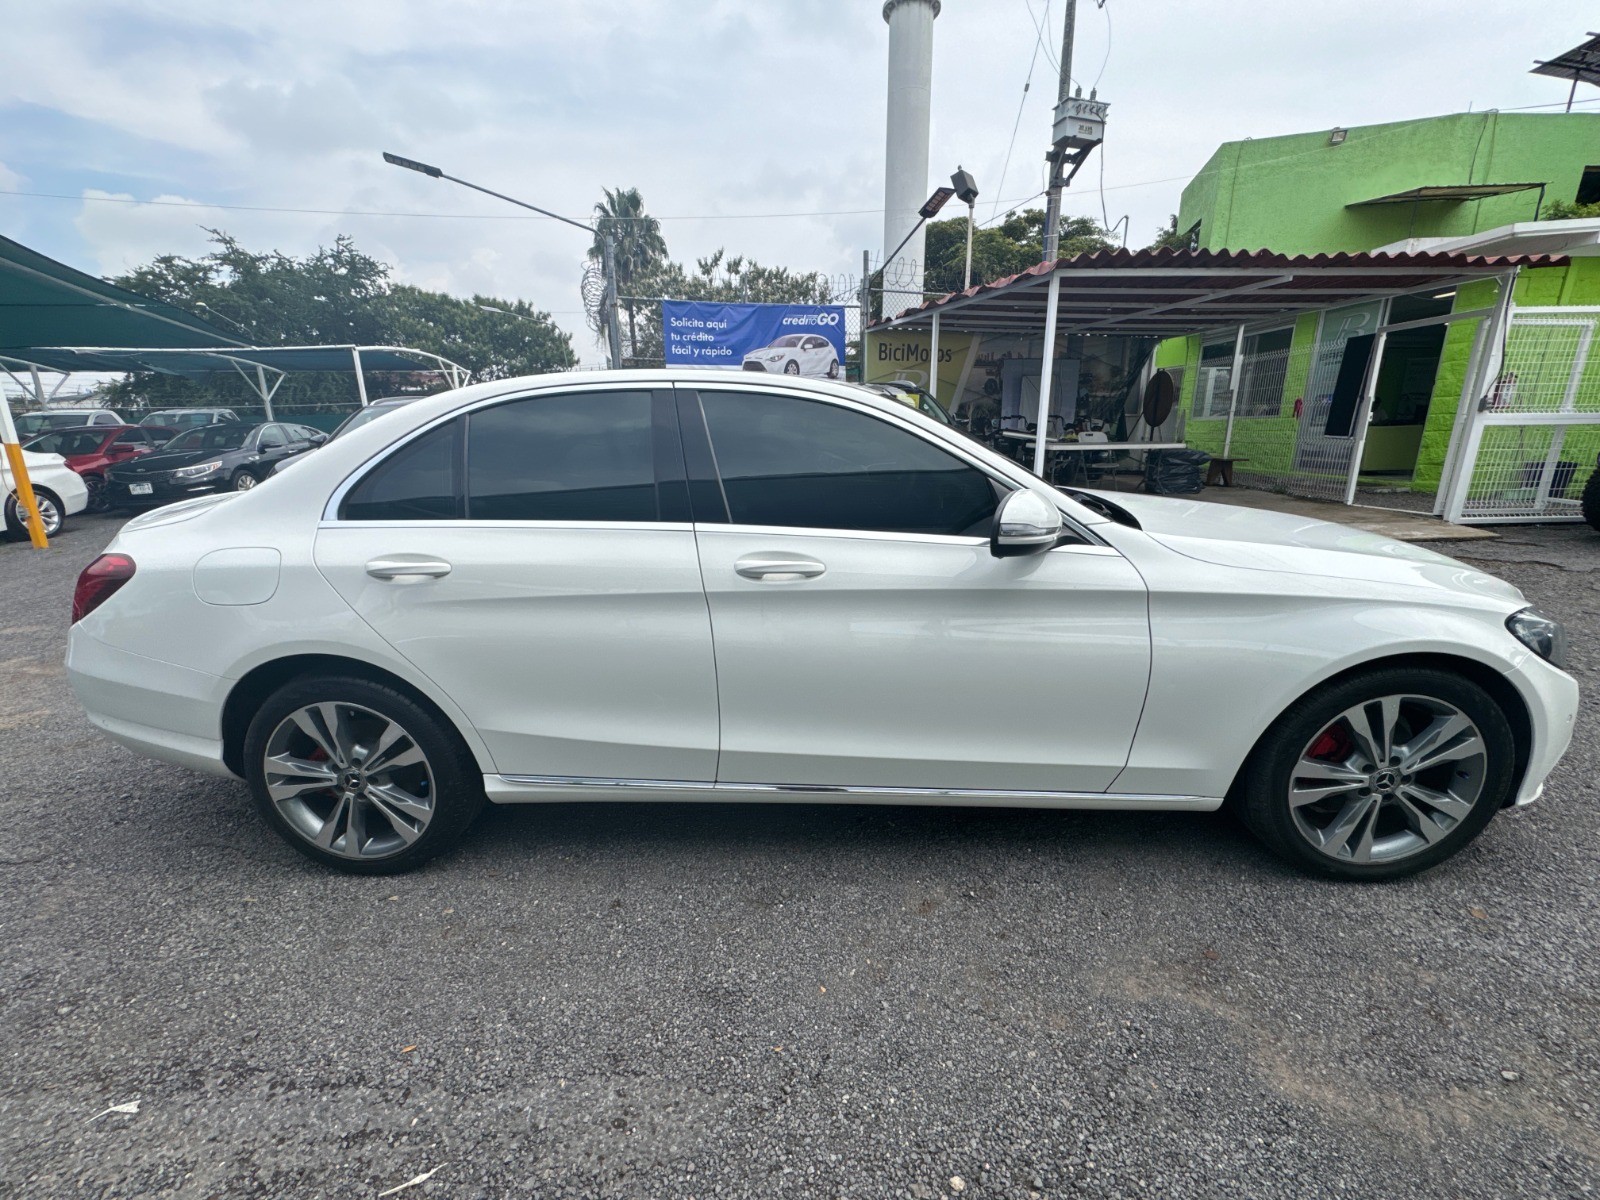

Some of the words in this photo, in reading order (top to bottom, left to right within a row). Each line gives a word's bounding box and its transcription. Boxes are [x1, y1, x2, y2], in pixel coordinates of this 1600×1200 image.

[670, 317, 704, 328] Solicita
[706, 319, 727, 330] aquí
[670, 332, 681, 341] tu
[682, 332, 715, 342] crédito
[671, 344, 692, 355] fácil
[693, 348, 700, 357] y
[701, 346, 732, 357] rápido
[878, 342, 952, 363] BiciMoos
